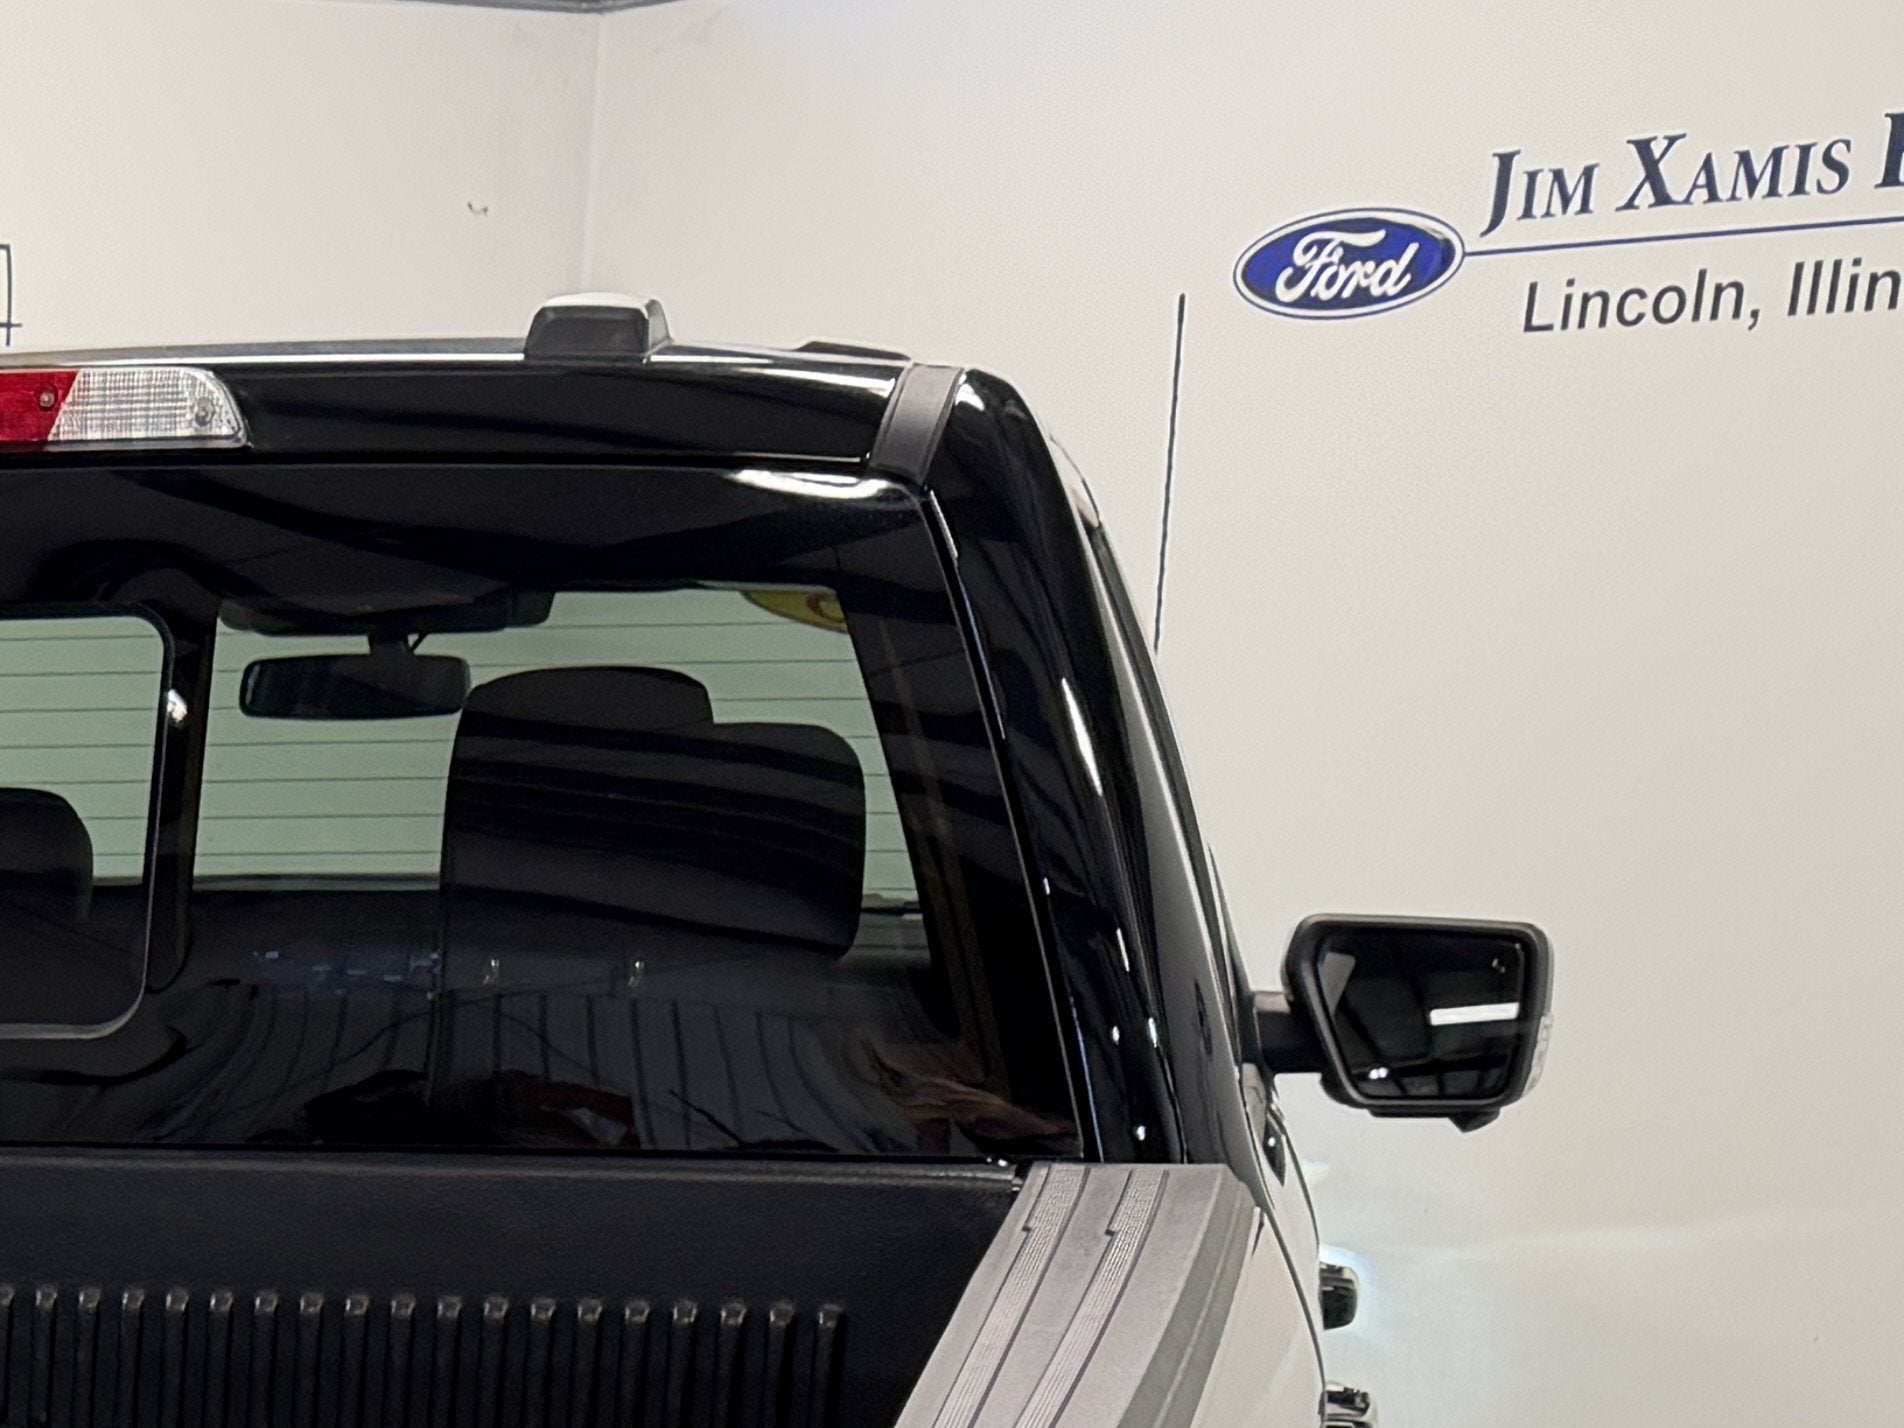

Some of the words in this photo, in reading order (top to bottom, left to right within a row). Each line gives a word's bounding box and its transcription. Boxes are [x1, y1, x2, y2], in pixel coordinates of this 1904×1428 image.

[1479, 149, 1600, 238] JIM
[1615, 132, 1852, 212] XAMIS
[1274, 229, 1421, 302] Ford
[1523, 268, 1761, 332] Lincoln,
[1787, 257, 1904, 317] Illin
